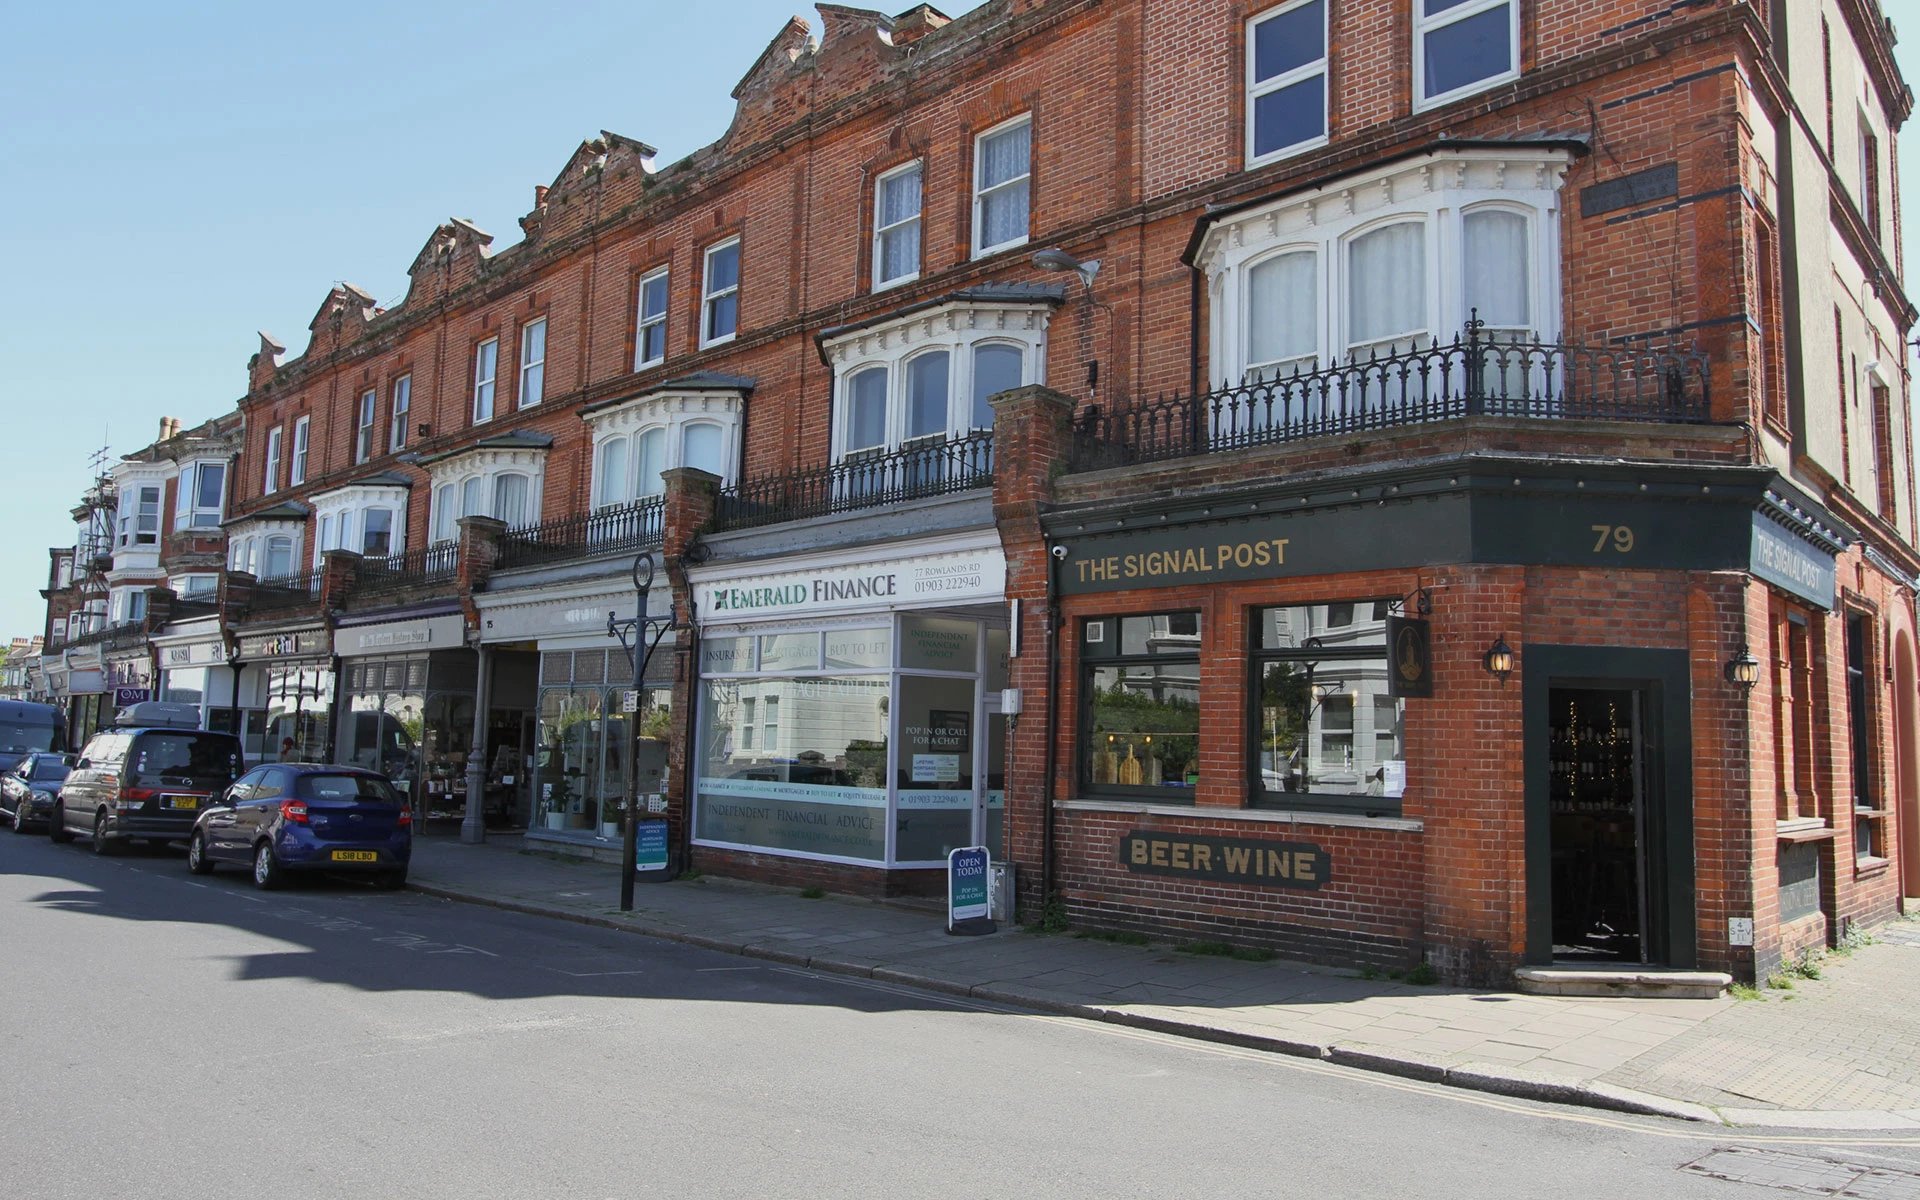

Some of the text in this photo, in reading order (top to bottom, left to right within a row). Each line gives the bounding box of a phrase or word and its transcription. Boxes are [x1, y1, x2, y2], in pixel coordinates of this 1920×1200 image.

[1591, 524, 1635, 553] 79
[1075, 538, 1290, 582] THE SIGNAL POST
[1757, 534, 1821, 591] THE SIGNAL POST
[914, 562, 981, 578] 77 ROWLANDS RD
[914, 575, 981, 593] 01903 222940
[730, 574, 896, 610] EMERALD FINANCE
[910, 629, 968, 641] INDEPENDENT
[918, 640, 960, 649] FINANCIAL
[705, 648, 753, 662] INSURANCE
[828, 645, 848, 656] BUY
[851, 643, 865, 655] TO
[868, 642, 886, 654] LET
[923, 650, 953, 658] ADVICE
[121, 690, 144, 699] OM
[905, 727, 921, 735] POP
[934, 728, 947, 736] OR
[948, 728, 968, 736] CALL
[913, 736, 930, 745] FOR
[778, 787, 806, 795] MORTGAGES
[843, 792, 860, 800] EQUITY
[908, 795, 958, 803] 01903 222940
[708, 804, 875, 830] INDEPENDENT FINANCIAL ADVICE
[336, 852, 355, 860] LS18
[1131, 839, 1316, 881] BEER WINE
[959, 857, 981, 868] OPEN
[957, 866, 984, 877] TODAY
[1730, 927, 1736, 936] S
